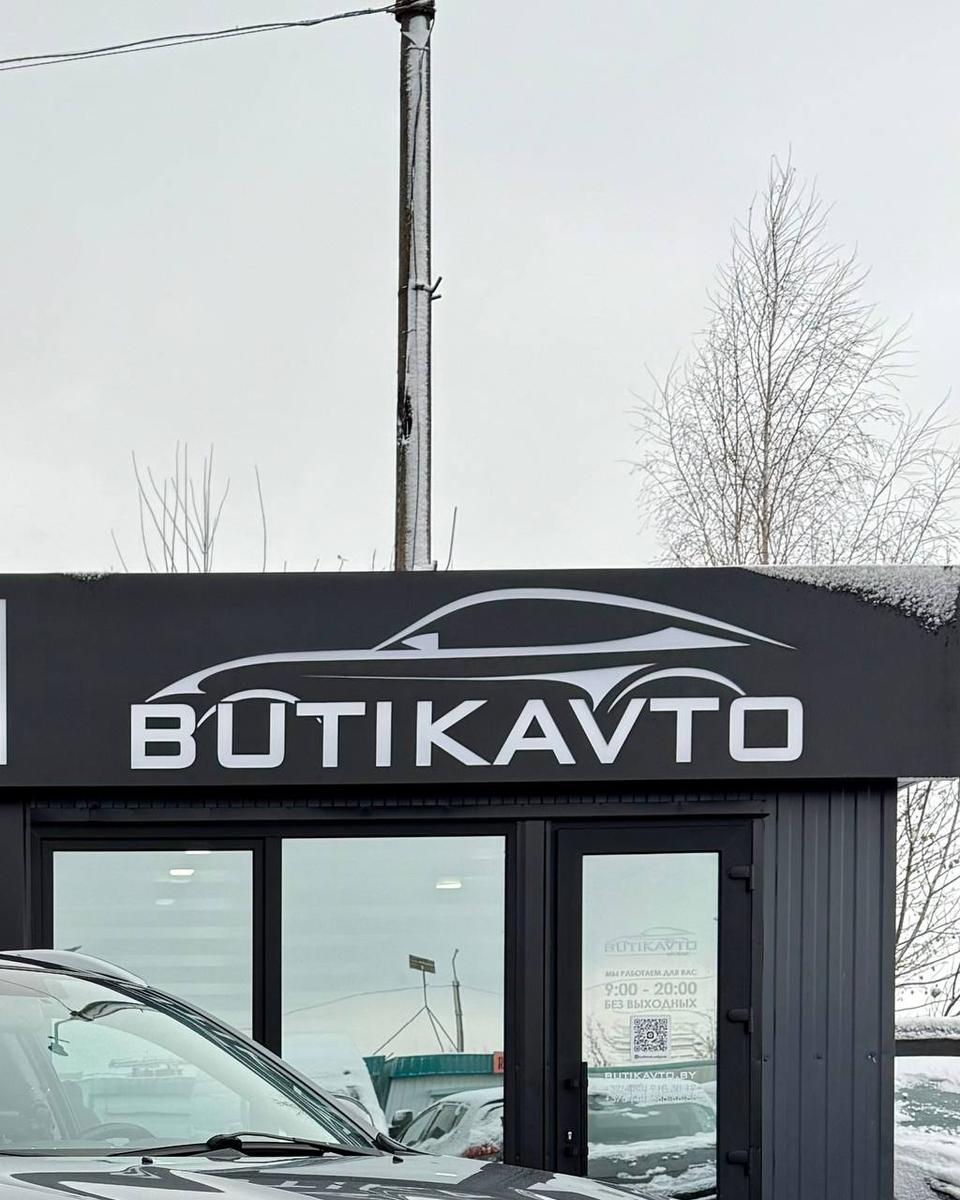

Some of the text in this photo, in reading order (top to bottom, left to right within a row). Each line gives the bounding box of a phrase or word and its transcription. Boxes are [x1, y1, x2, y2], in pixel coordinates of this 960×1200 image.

[130, 695, 804, 770] BUTIKAVTO
[604, 941, 697, 953] BUTIKAVTO
[605, 983, 638, 997] 9:00
[654, 981, 697, 996] 20:00
[604, 999, 697, 1011] БЕЗ ВЫХОДНЫХ
